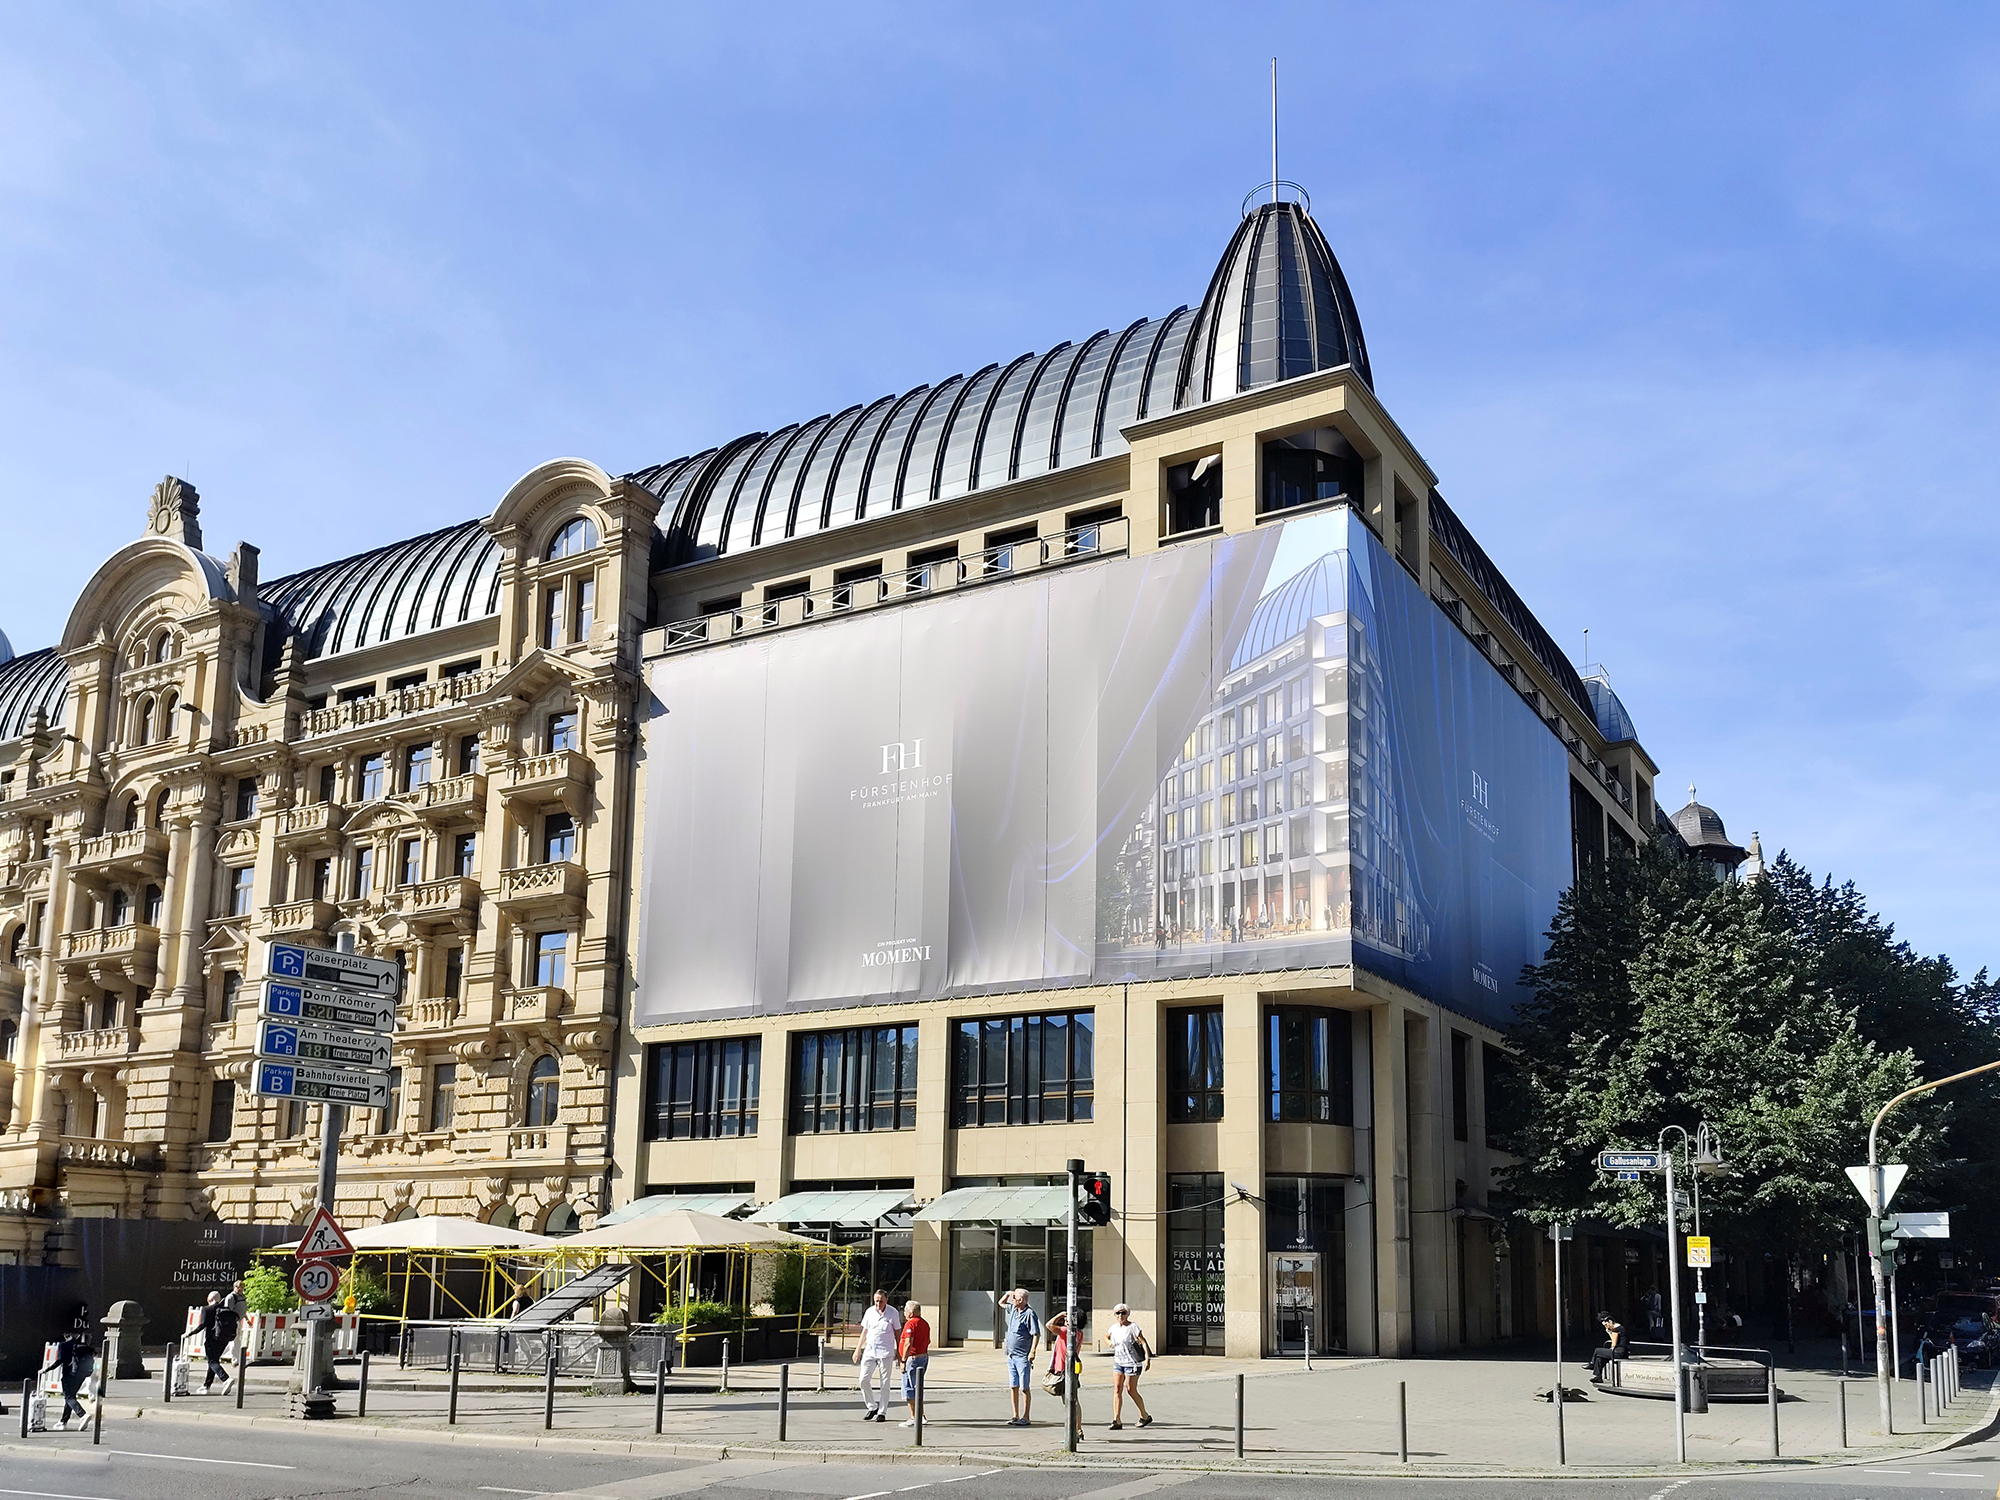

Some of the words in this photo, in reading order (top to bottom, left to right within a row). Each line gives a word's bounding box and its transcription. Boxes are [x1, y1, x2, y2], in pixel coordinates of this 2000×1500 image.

[879, 738, 924, 775] FH
[850, 773, 953, 801] FÜRSTENHOF
[863, 796, 904, 809] FRANKFURT
[906, 794, 917, 802] AM
[919, 791, 938, 799] MAIN
[306, 951, 368, 970] Kaiserplatz
[861, 945, 931, 968] MOMENI
[1472, 967, 1498, 993] MOMENI
[271, 987, 300, 997] Parken
[278, 997, 292, 1012] D
[308, 1004, 334, 1020] 520
[300, 1029, 318, 1040] Am
[322, 1032, 363, 1045] Theater
[264, 1066, 292, 1077] Parken
[296, 1068, 370, 1085] Bahnhofsviertel
[270, 1076, 284, 1092] B
[1609, 1157, 1651, 1167] Gallusanlage
[1173, 1251, 1202, 1259] FRESH
[1206, 1251, 1225, 1259] MA
[180, 1259, 235, 1271] Frankfurt,
[173, 1271, 190, 1282] Du
[192, 1271, 218, 1282] hast
[303, 1271, 328, 1289] 30
[1173, 1273, 1194, 1281] JUICES
[1173, 1302, 1193, 1312] HOT
[74, 1318, 90, 1329] Du
[1206, 1315, 1225, 1323] SOU
